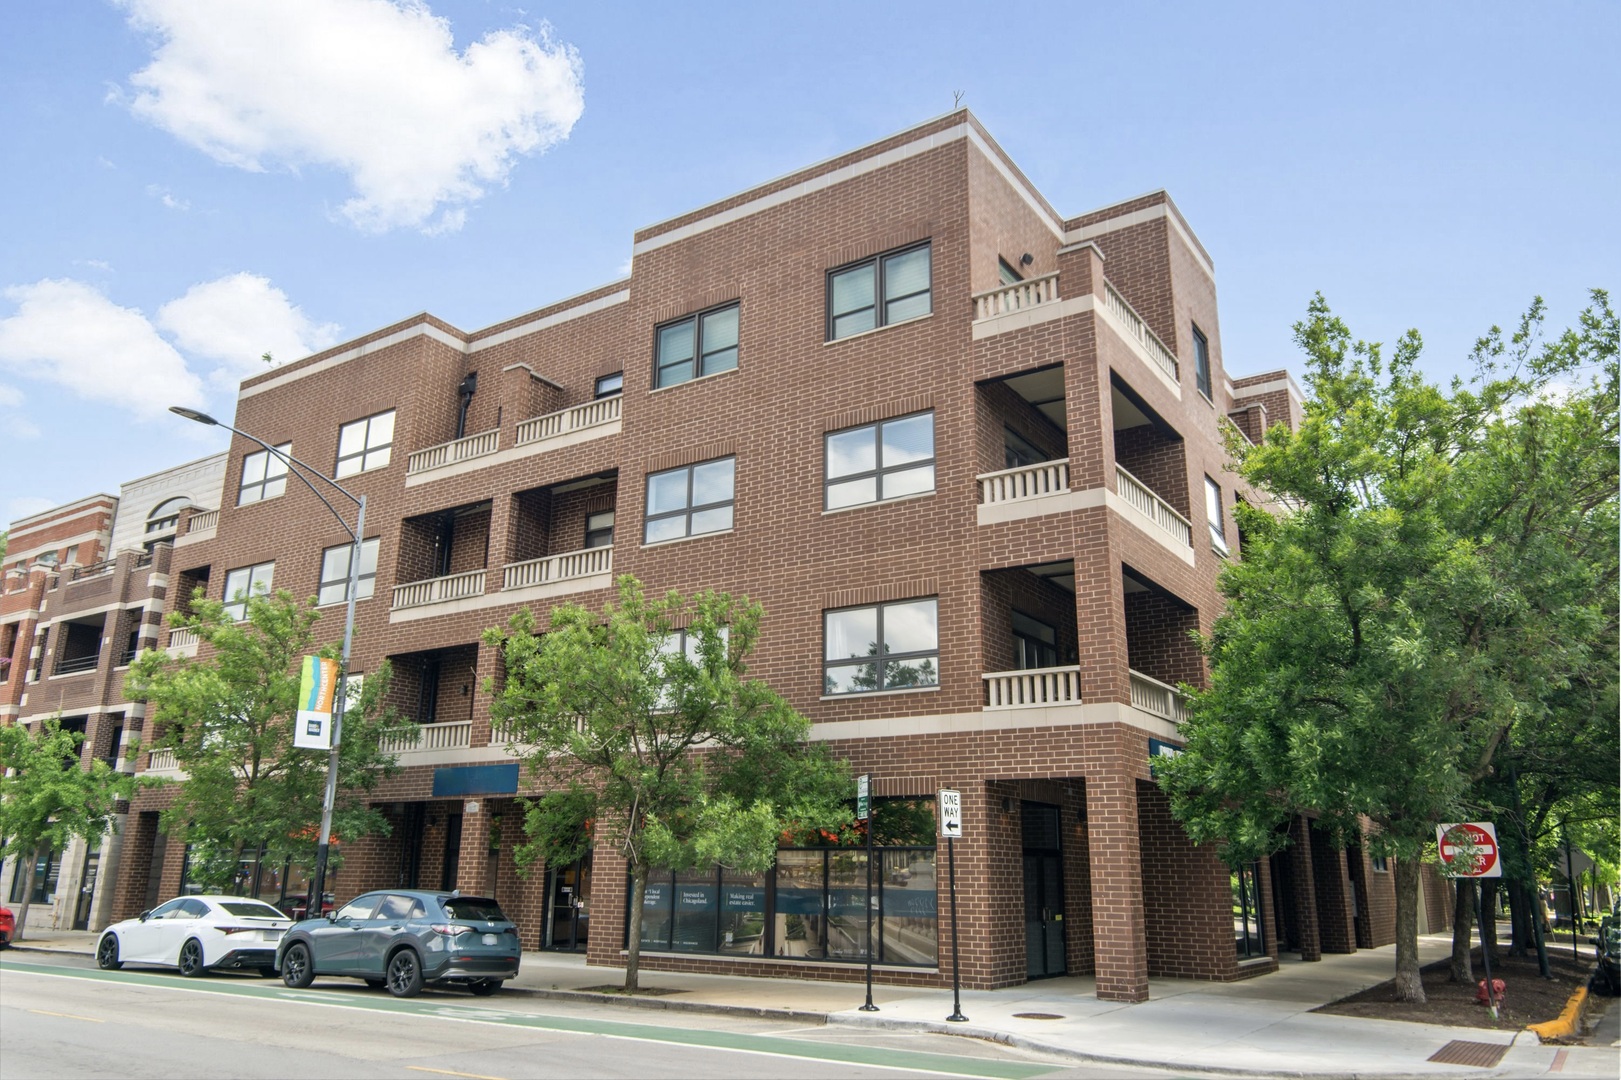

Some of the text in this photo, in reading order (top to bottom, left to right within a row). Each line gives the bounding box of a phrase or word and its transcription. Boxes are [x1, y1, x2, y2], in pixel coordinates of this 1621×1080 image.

[316, 661, 329, 711] NORTHCENTER
[944, 794, 958, 805] ONE
[944, 807, 959, 818] WAY
